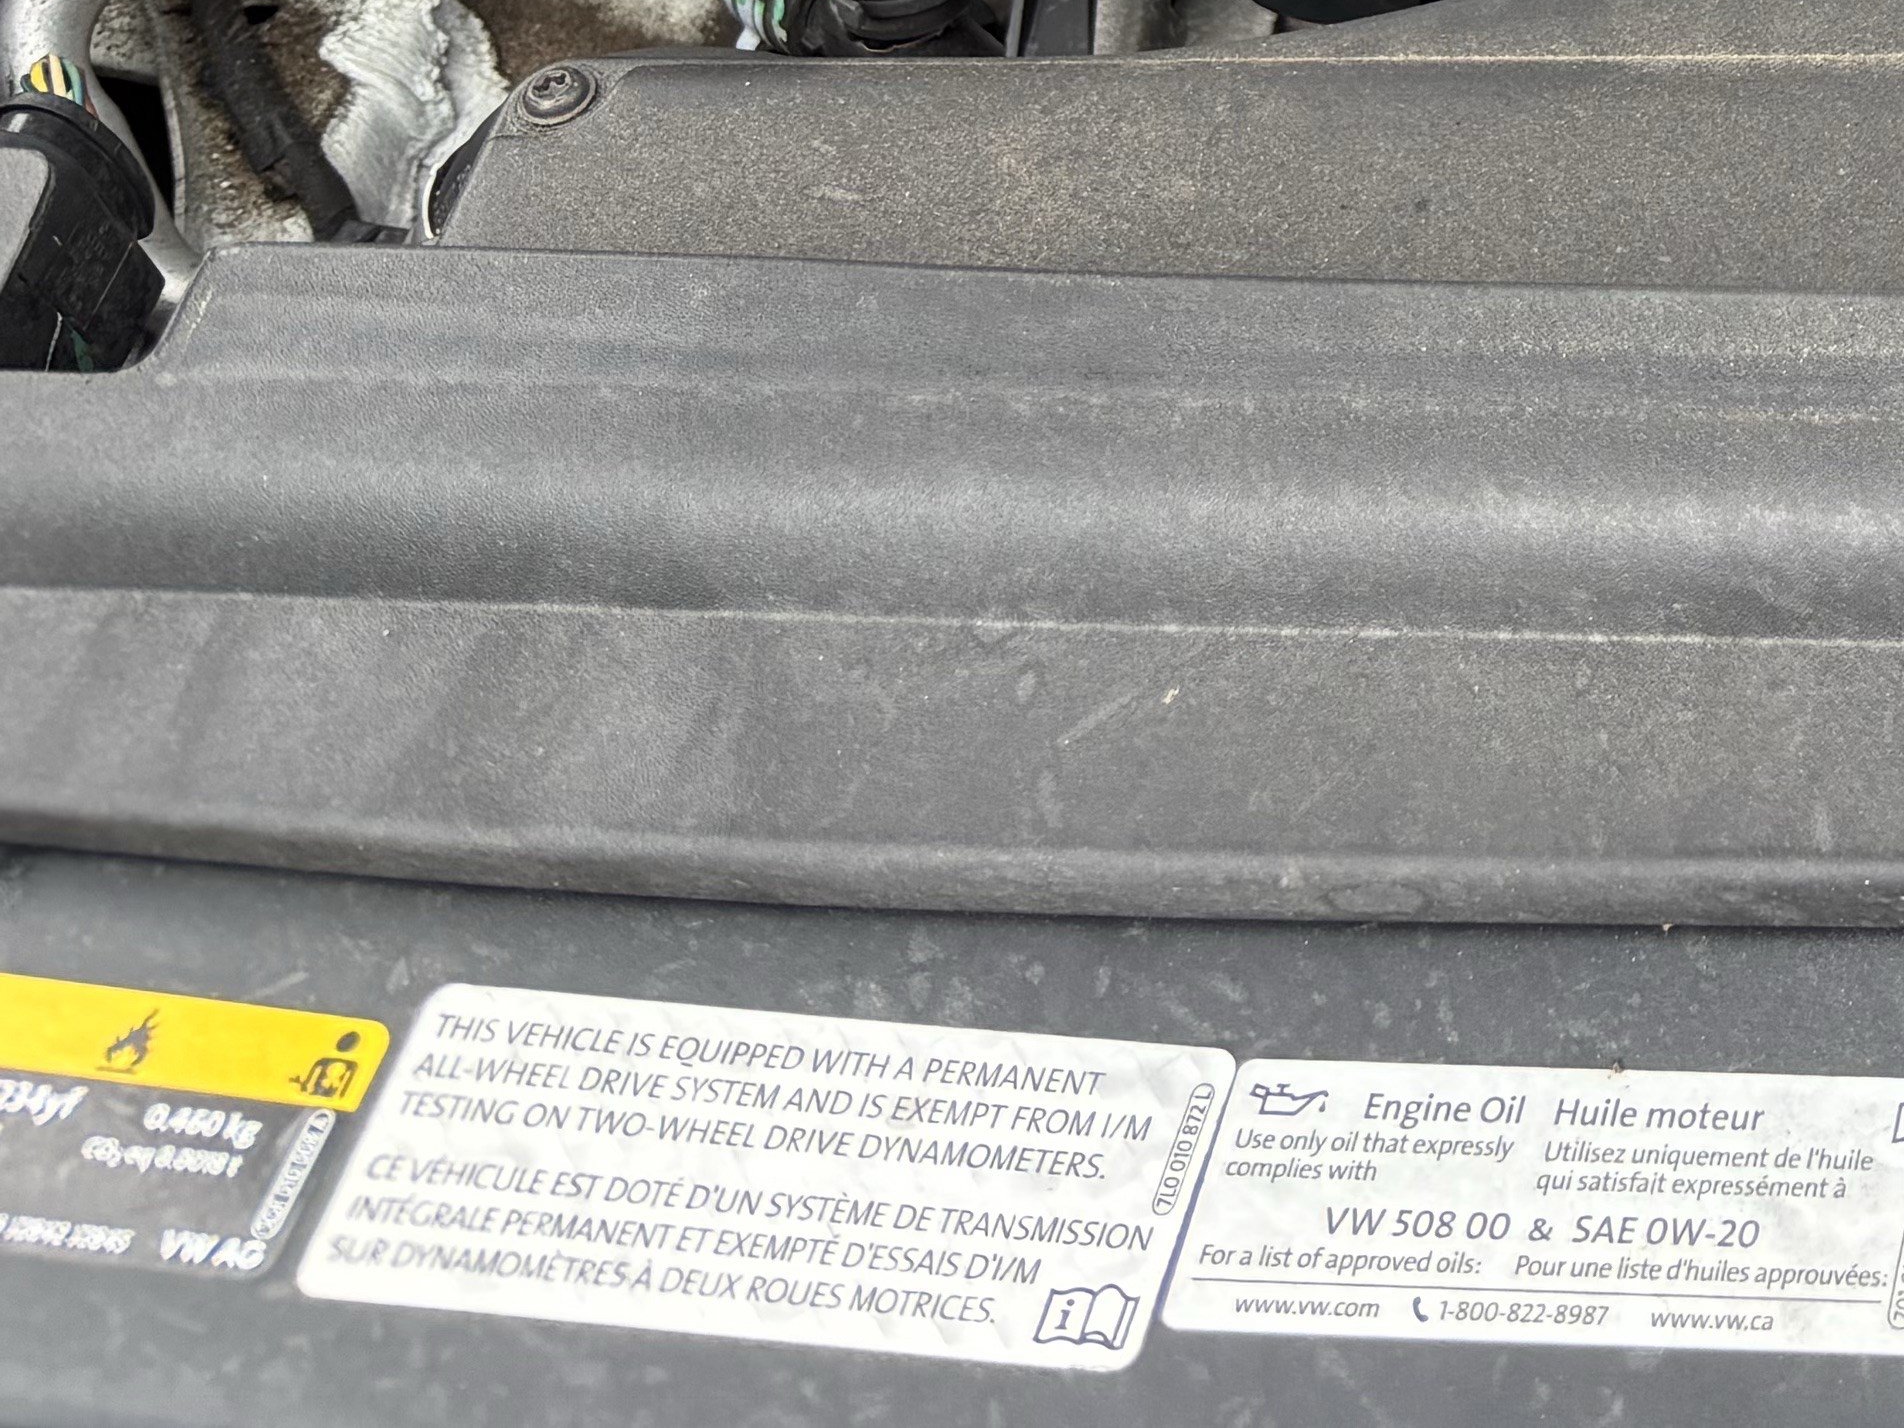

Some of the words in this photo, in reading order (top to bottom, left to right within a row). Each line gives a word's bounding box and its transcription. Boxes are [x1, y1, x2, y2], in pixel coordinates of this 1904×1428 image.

[436, 1013, 500, 1043] THIS
[507, 1020, 625, 1055] VEHICLE
[626, 1032, 655, 1057] IS
[658, 1035, 806, 1070] EQUIPPED
[811, 1047, 891, 1079] WITH
[892, 1056, 914, 1081] A
[921, 1057, 1108, 1096] PERMANENT
[412, 1052, 570, 1089] ALL-WHEEL
[577, 1066, 669, 1099] DRIVE
[670, 1076, 781, 1110] SYSTEM
[782, 1087, 853, 1115] AND
[857, 1092, 888, 1119] IS
[890, 1095, 1009, 1129] EXEMPT
[1010, 1105, 1097, 1137] FROM
[1100, 1112, 1153, 1142] I/M
[1363, 1092, 1472, 1130] Engine
[1479, 1095, 1527, 1124] Oil
[1553, 1097, 1638, 1128] Huile
[1645, 1102, 1766, 1131] moteur
[399, 1090, 520, 1126] TESTING
[522, 1102, 572, 1130] ON
[577, 1106, 755, 1149] TWO-WHEEL
[763, 1124, 866, 1159] DRIVE
[857, 1133, 1106, 1180] DYNAMOMETERS.
[1234, 1127, 1276, 1150] Use
[1279, 1128, 1328, 1158] only
[1330, 1130, 1360, 1153] oil
[1362, 1131, 1410, 1155] that
[1411, 1134, 1515, 1164] expressly
[1224, 1156, 1324, 1184] complies
[1328, 1159, 1378, 1182] with
[1544, 1140, 1627, 1164] Utilisez
[1629, 1147, 1770, 1180] uniquement
[1773, 1146, 1802, 1169] de
[1805, 1147, 1874, 1172] l'huile
[365, 1153, 402, 1182] CE
[409, 1154, 549, 1196] VÉHICULE
[549, 1171, 604, 1200] EST
[603, 1176, 684, 1208] DOTÉ
[684, 1184, 764, 1216] D'UN
[764, 1190, 891, 1228] SYSTÈME
[892, 1203, 936, 1232] DE
[940, 1204, 1159, 1252] TRANSMISSION
[1536, 1174, 1573, 1197] qui
[1576, 1170, 1667, 1196] satisfait
[1671, 1174, 1830, 1202] expressément
[1832, 1176, 1847, 1199] à
[1326, 1206, 1387, 1236] VW
[1391, 1209, 1457, 1239] 508
[1465, 1211, 1511, 1241] 00
[1527, 1217, 1554, 1242] &
[1571, 1214, 1639, 1244] SAE
[1646, 1217, 1761, 1249] 0W-20
[160, 1229, 211, 1265] VW
[211, 1238, 268, 1270] AG
[1198, 1243, 1237, 1266] For
[1238, 1250, 1253, 1266] a
[1258, 1244, 1294, 1268] list
[1296, 1246, 1326, 1269] of
[1324, 1250, 1433, 1277] approved
[1436, 1250, 1482, 1274] oils:
[1514, 1254, 1567, 1277] Pour
[1569, 1261, 1613, 1279] une
[1616, 1256, 1663, 1281] liste
[1666, 1257, 1751, 1283] d'huiles
[1753, 1263, 1888, 1291] approuvées:
[1235, 1298, 1380, 1318] www.vw.com
[1439, 1300, 1610, 1326] 1-800-822-8987
[1651, 1312, 1774, 1332] www.vw.ca
